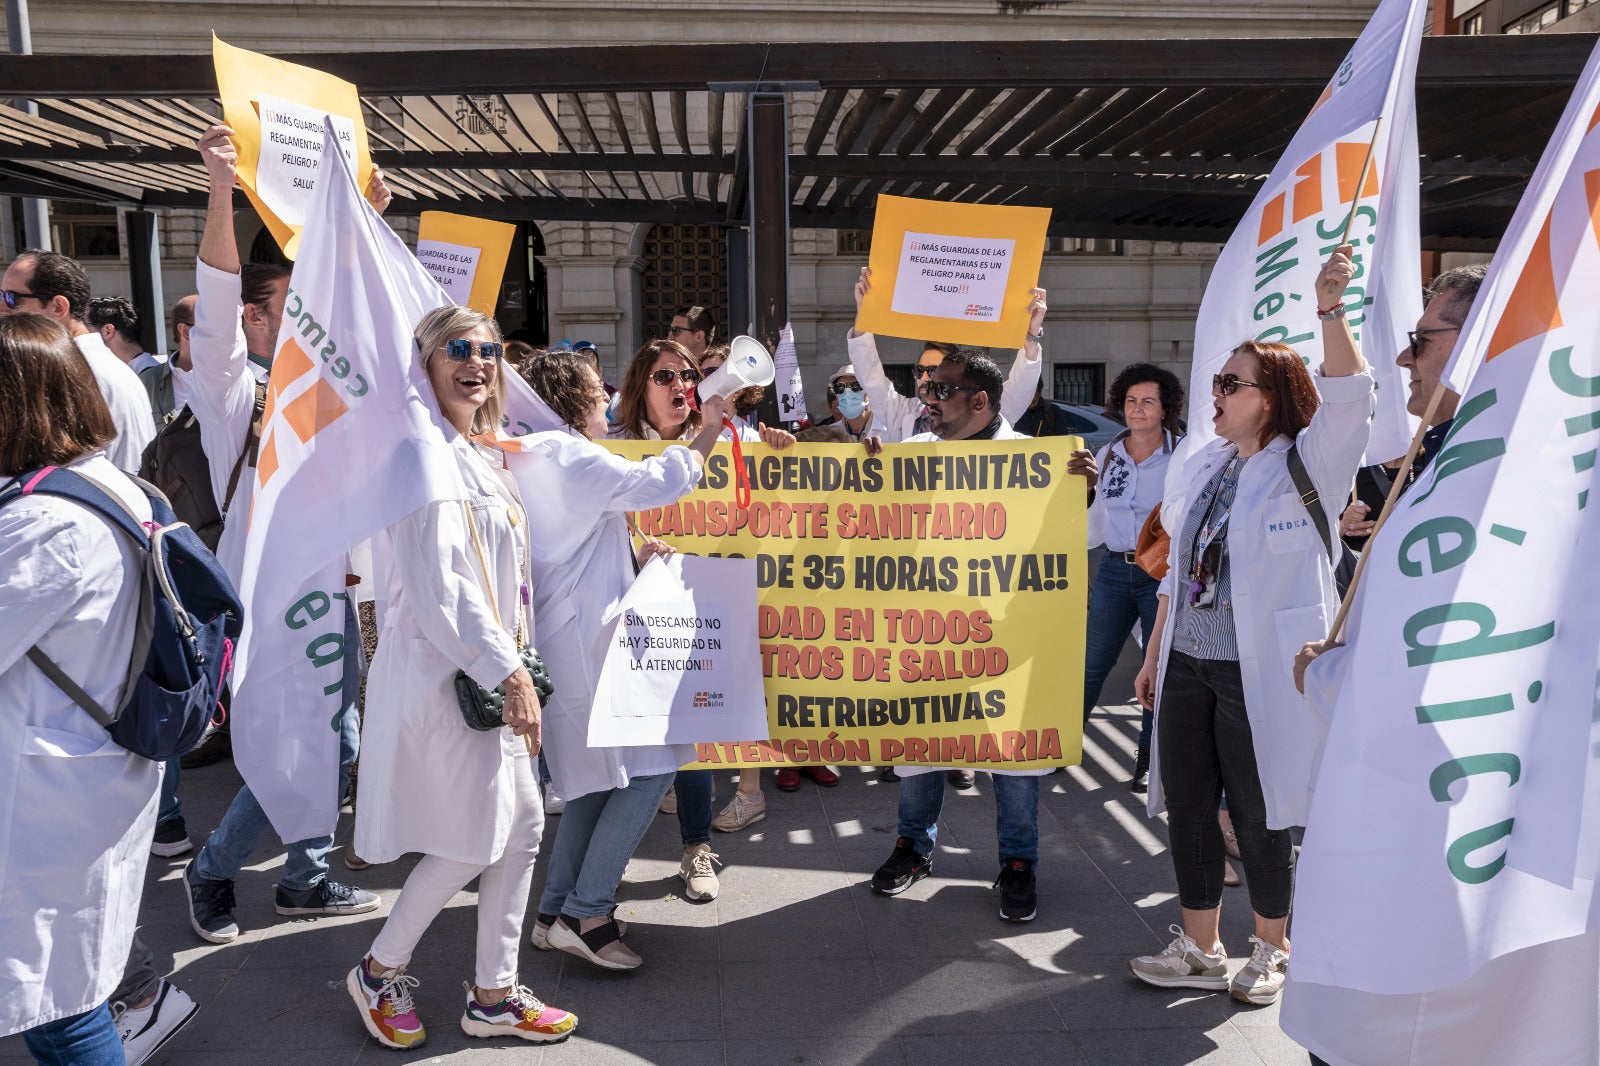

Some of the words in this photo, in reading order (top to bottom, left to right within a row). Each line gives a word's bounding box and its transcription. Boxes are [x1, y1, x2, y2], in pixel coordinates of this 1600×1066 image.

[338, 130, 351, 141] LAS
[282, 153, 312, 168] PELIGRO
[940, 245, 980, 255] GUARDIAS
[981, 248, 991, 256] DE
[992, 249, 1006, 257] LAS
[449, 253, 459, 262] DE
[460, 255, 472, 264] LAS
[910, 255, 978, 268] REGLAMENTARIAS
[979, 261, 988, 269] ES
[447, 266, 456, 274] ES
[457, 268, 468, 276] UN
[921, 268, 953, 278] PELIGRO
[954, 272, 975, 280] PARA
[976, 273, 986, 281] LA
[933, 284, 969, 294] SALUD!!!
[738, 455, 884, 492] AGENDAS
[893, 452, 1051, 491] INFINITAS
[836, 502, 1007, 541] SANITARIO
[757, 554, 794, 588] DE
[803, 554, 845, 590] 35
[855, 556, 959, 592] HORAS
[967, 554, 1069, 597] ¡¡YA!!
[647, 615, 702, 629] DESCANSO
[705, 618, 721, 629] NO
[834, 608, 874, 643] EN
[884, 609, 993, 644] TODOS
[619, 636, 641, 648] HAY
[644, 637, 705, 650] SEGURIDAD
[708, 638, 721, 650] EN
[630, 659, 643, 671] LA
[646, 656, 713, 671] ATENCIÓN!!!
[853, 647, 891, 682] DE
[899, 646, 1009, 683] SALUD
[778, 689, 1006, 727] RETRIBUTIVAS
[696, 731, 871, 763] ATENCIÓN
[880, 728, 1063, 763] PRIMARIA
